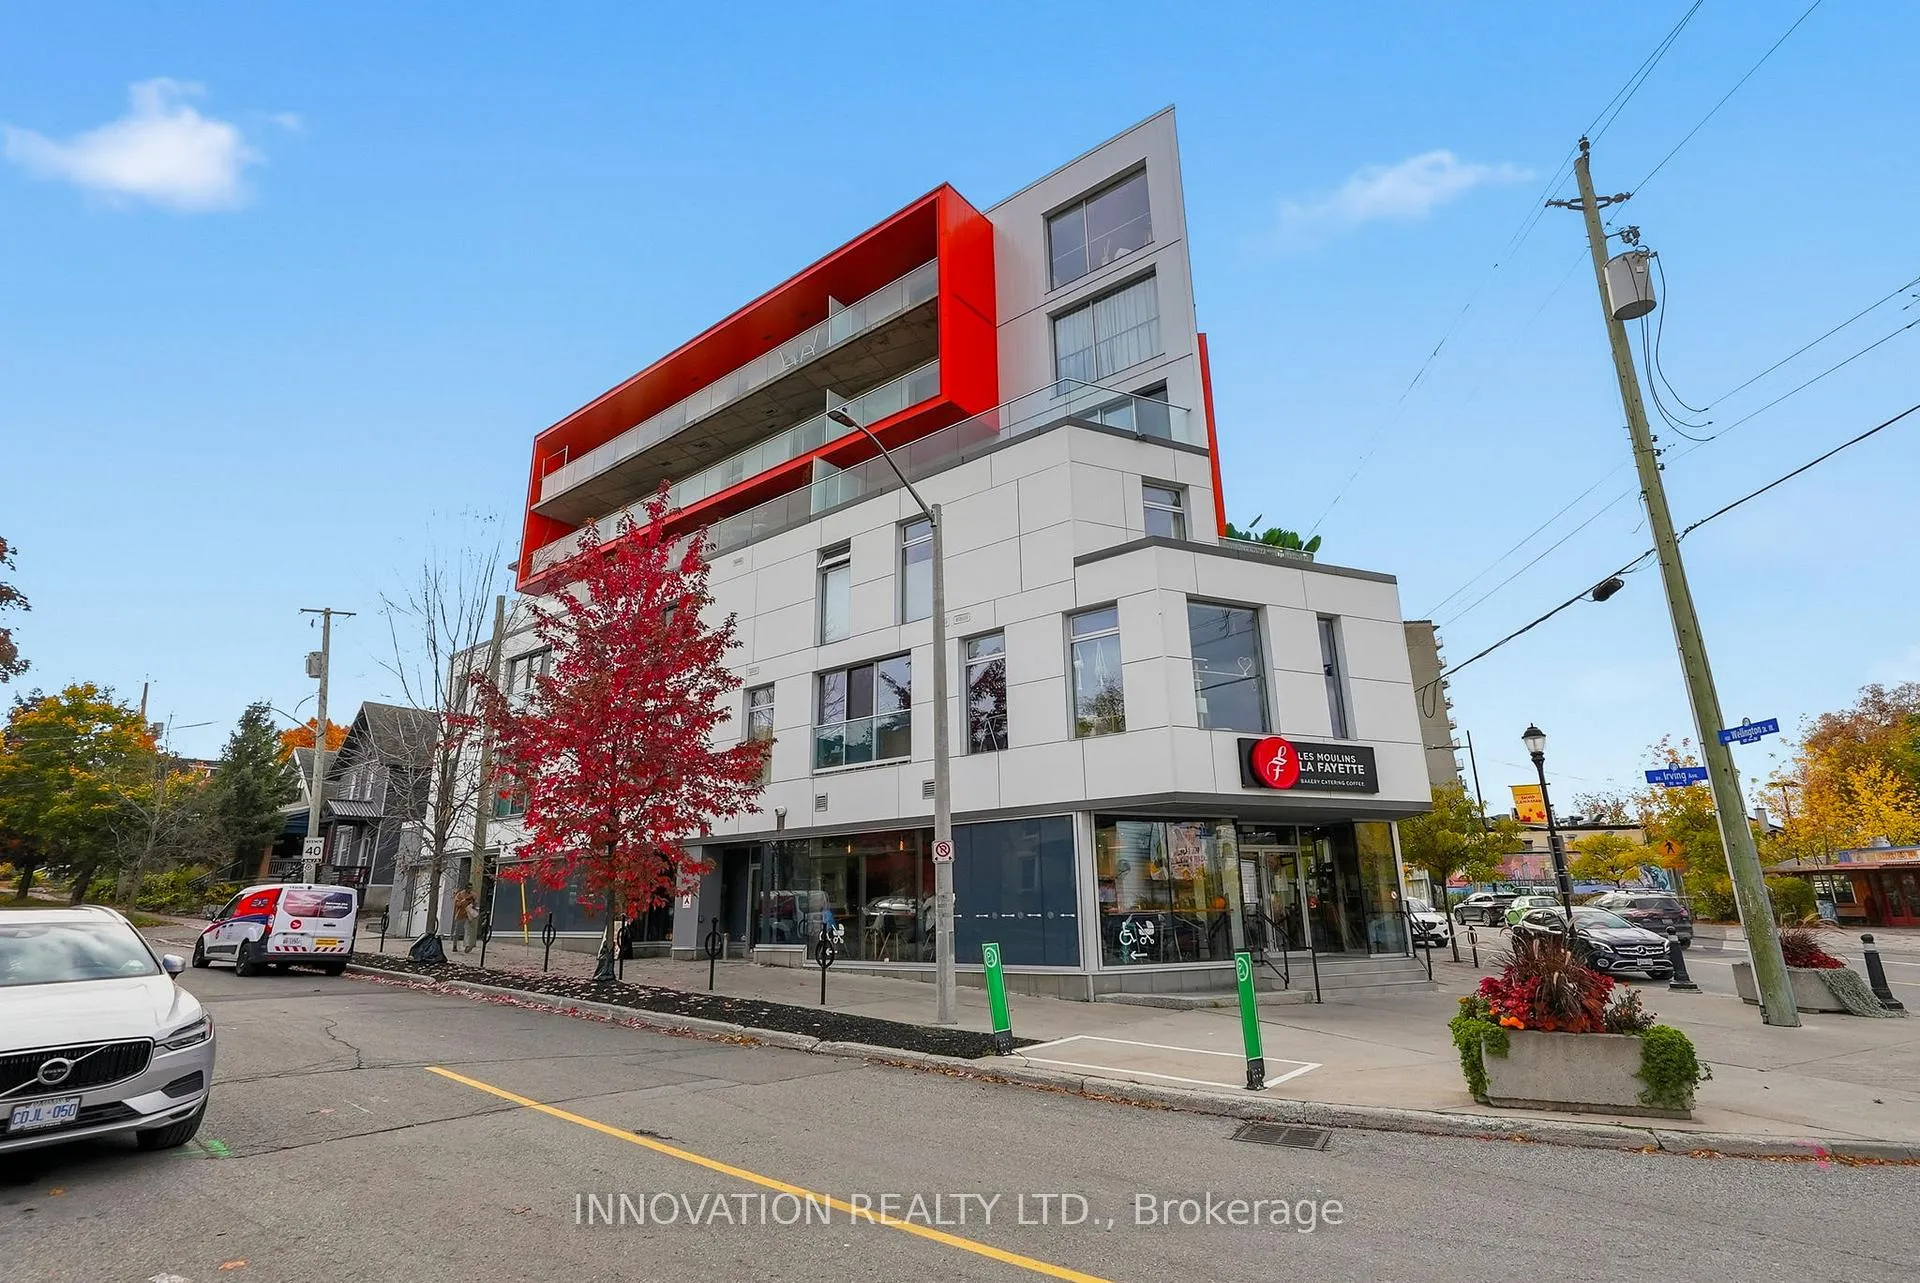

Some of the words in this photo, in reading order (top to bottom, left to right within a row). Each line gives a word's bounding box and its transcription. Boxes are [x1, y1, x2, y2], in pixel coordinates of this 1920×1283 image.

[1297, 752, 1314, 761] LES
[1316, 753, 1356, 763] MOULINS
[1299, 761, 1315, 772] LA
[1317, 762, 1365, 775] FAYETTE
[1663, 771, 1687, 784] Irving
[305, 846, 321, 856] 40
